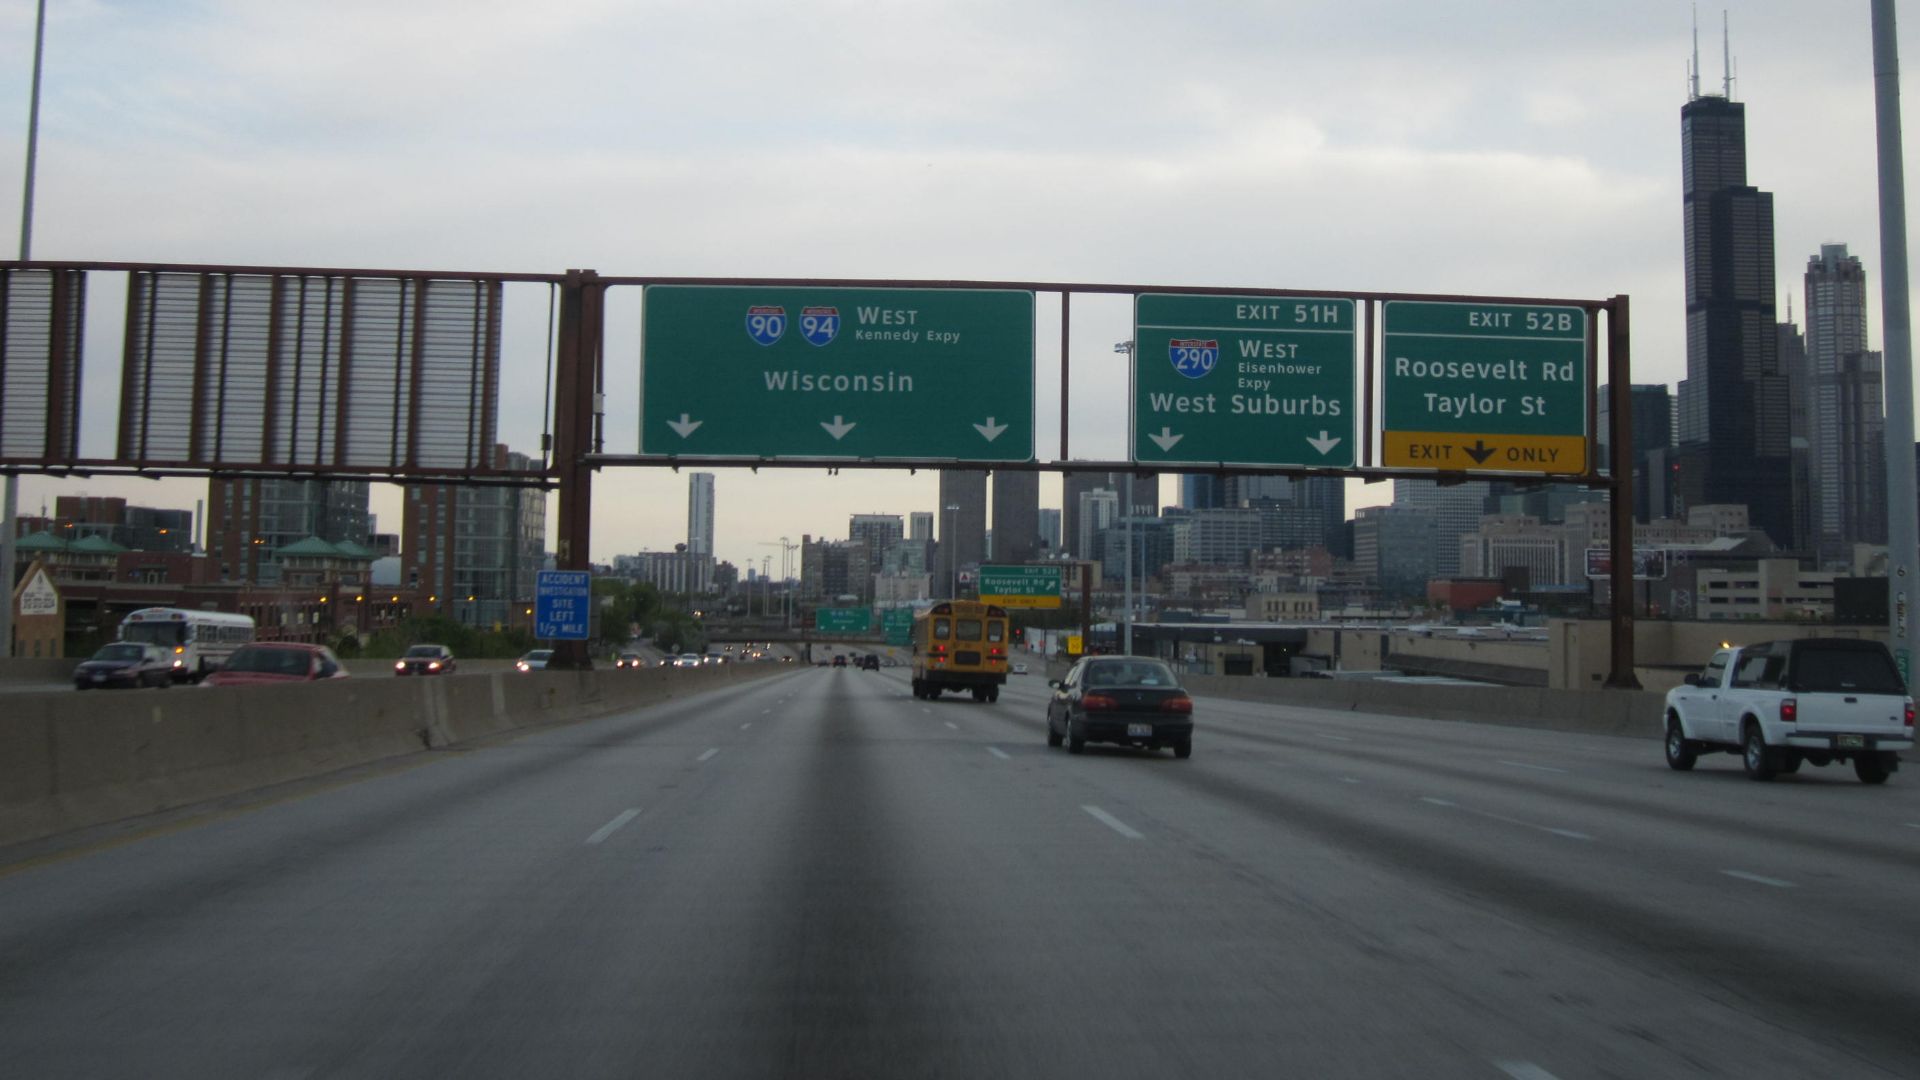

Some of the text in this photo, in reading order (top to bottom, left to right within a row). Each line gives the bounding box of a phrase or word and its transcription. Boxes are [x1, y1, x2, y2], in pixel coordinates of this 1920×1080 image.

[1236, 304, 1338, 323] EXIT 51H
[1468, 311, 1572, 331] EXIT 52B
[751, 316, 782, 337] 90
[803, 316, 834, 338] 94
[855, 329, 961, 344] Kennedy Expy
[1177, 349, 1213, 370] 290
[1238, 362, 1322, 375] Eisenhower
[1395, 357, 1574, 382] Roosevelt Rd
[763, 370, 914, 392] Wisconsin
[1238, 377, 1271, 392] Expy
[1149, 392, 1341, 416] West Suburbs
[1424, 393, 1546, 418] Taylor St
[1409, 444, 1559, 463] EXIT ONLY
[542, 574, 586, 585] ACCIDENT
[984, 578, 1029, 586] Roosevelt
[994, 586, 1022, 595] Taylor
[551, 599, 574, 609] SITE
[549, 611, 575, 622] LEFT
[539, 622, 584, 637] 1/2 MILE
